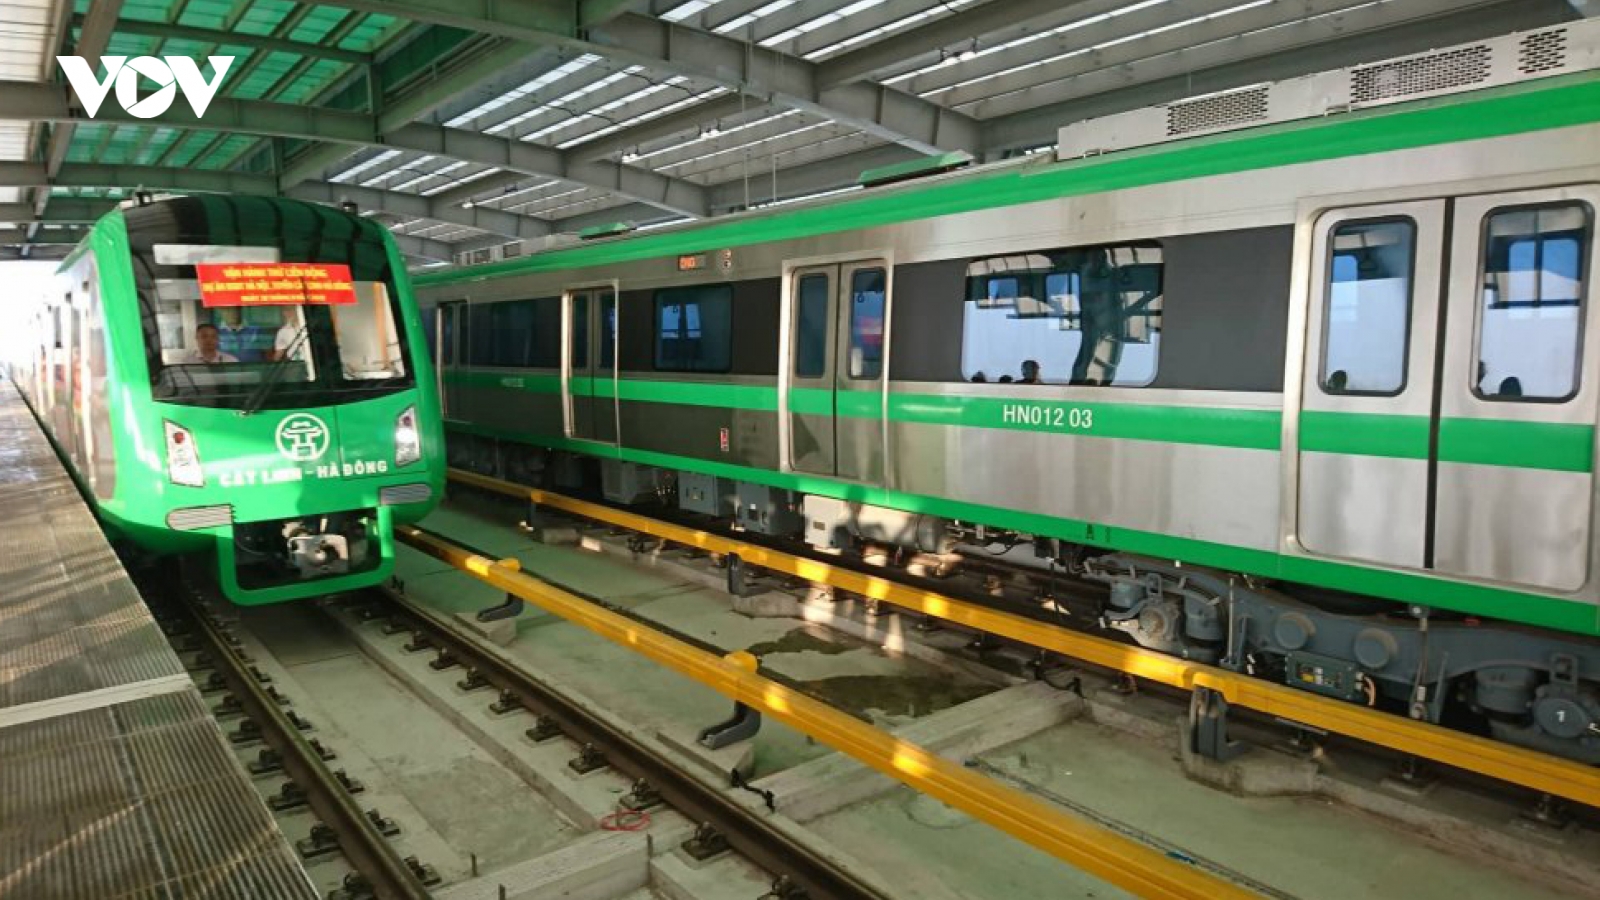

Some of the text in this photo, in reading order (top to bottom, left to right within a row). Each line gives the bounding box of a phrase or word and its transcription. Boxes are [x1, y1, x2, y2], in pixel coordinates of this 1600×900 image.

[1003, 404, 1093, 429] HN012 03
[316, 462, 340, 478] HÀ
